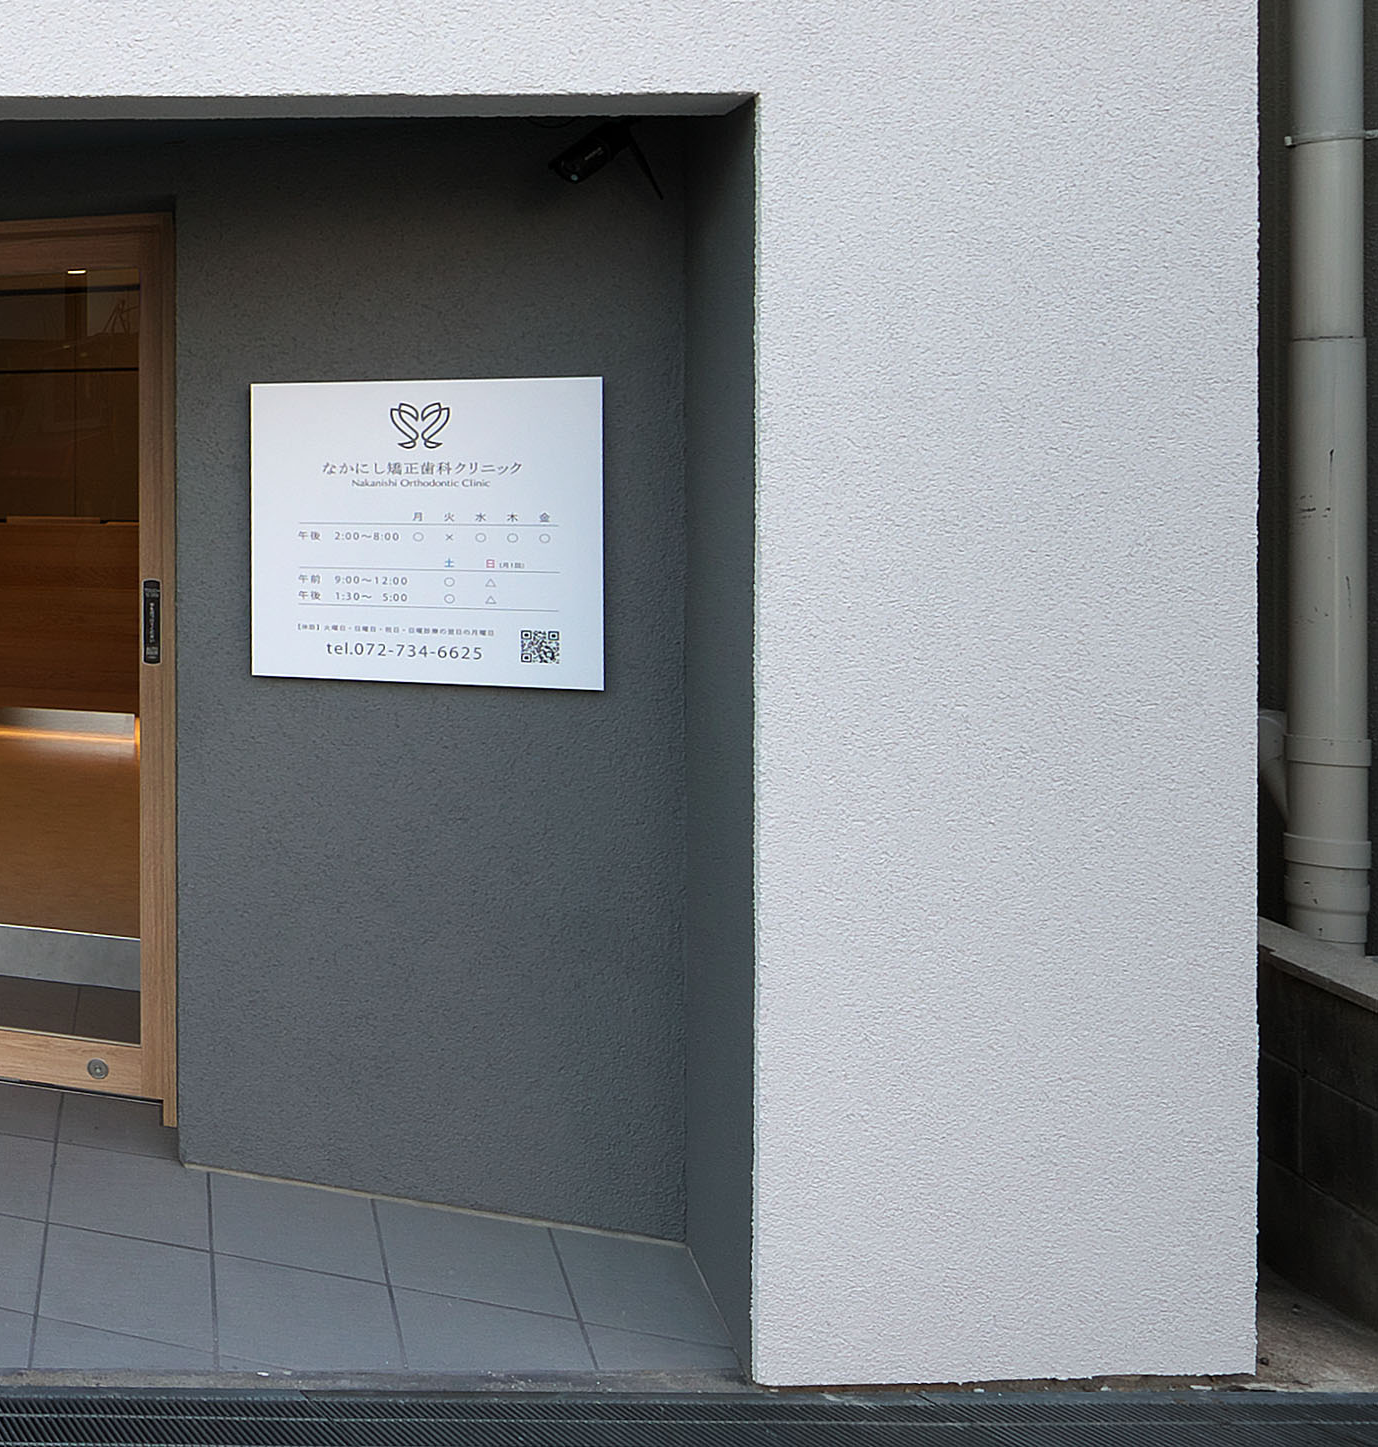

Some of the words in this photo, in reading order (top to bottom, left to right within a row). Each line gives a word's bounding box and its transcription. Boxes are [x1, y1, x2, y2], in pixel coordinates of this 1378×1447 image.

[322, 461, 523, 476] なかにし矯正歯科クリニック
[351, 479, 397, 488] Nakanishi
[400, 479, 459, 488] Orthodontic
[461, 479, 491, 488] Clinic
[326, 642, 483, 661] tel.072-734-6625
